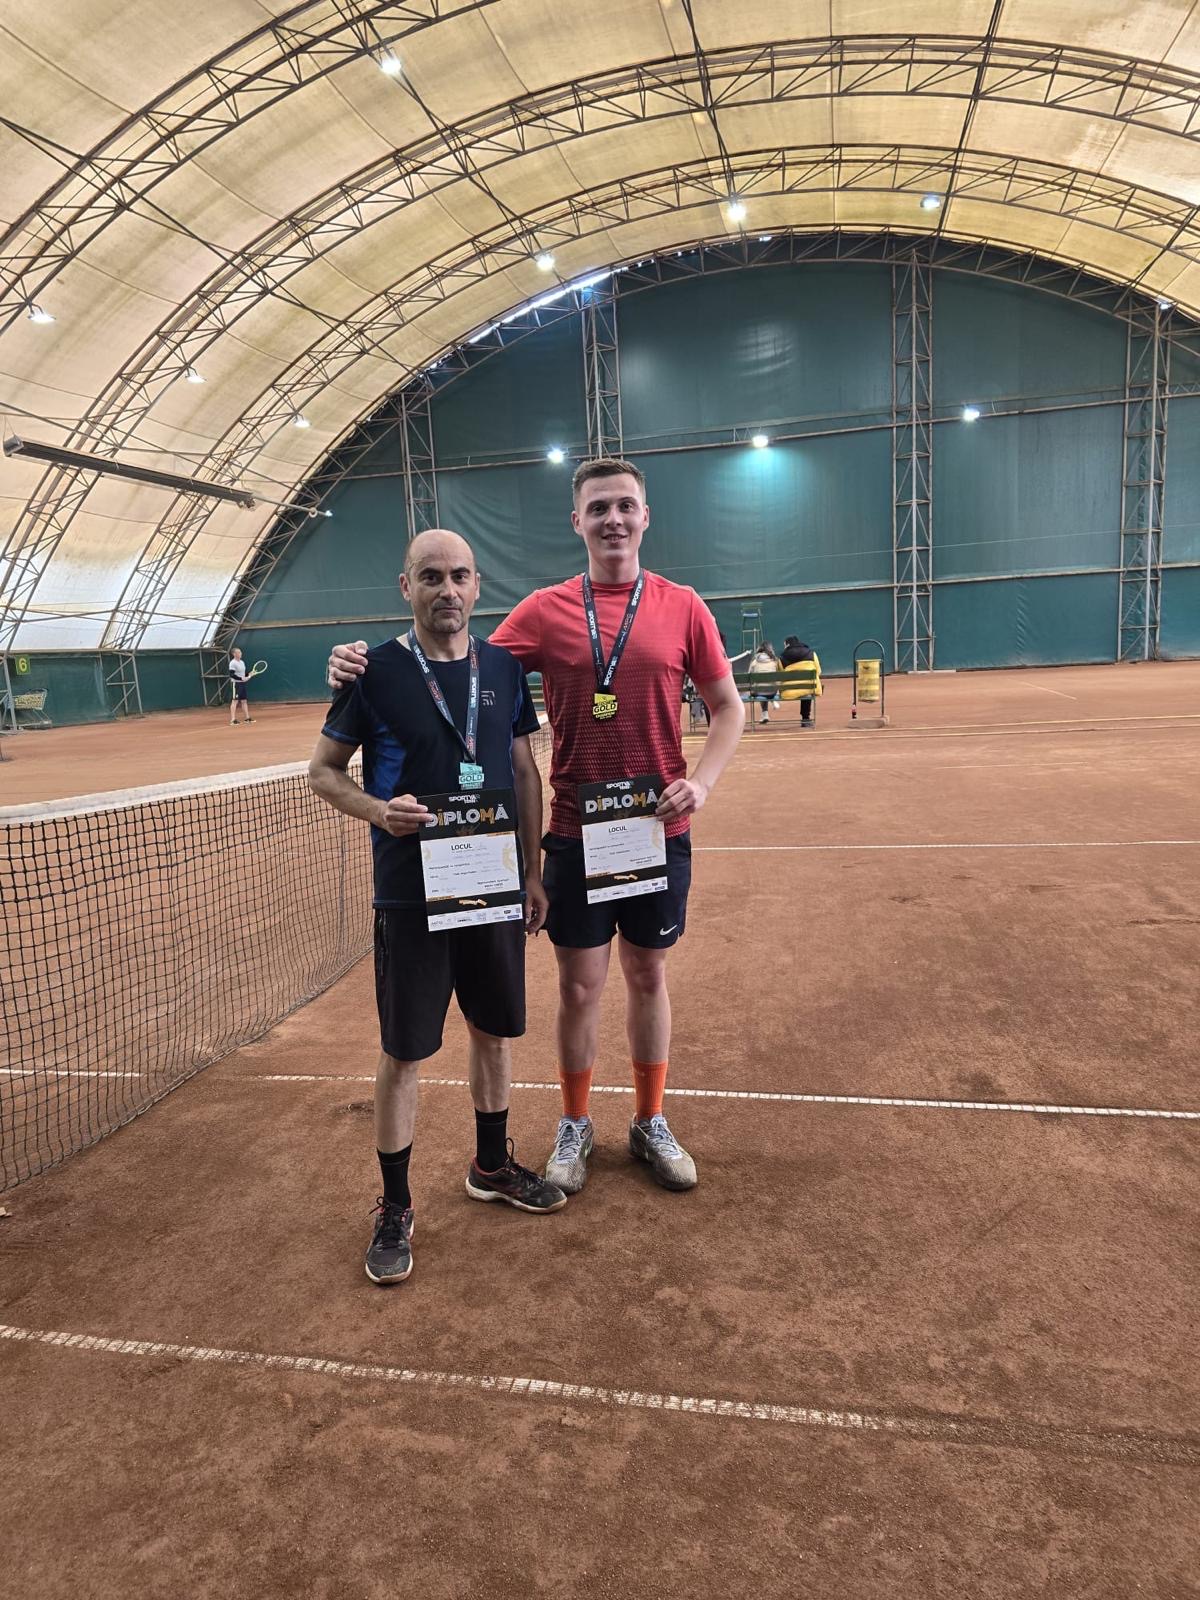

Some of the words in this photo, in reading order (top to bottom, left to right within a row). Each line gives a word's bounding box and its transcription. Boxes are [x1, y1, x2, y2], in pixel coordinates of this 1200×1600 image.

[19, 657, 28, 672] 6
[594, 703, 617, 713] GOLD
[459, 774, 483, 783] GOLD
[585, 788, 658, 814] DIPLOMĂ
[608, 825, 628, 833] LOCUL
[450, 843, 473, 851] LOCUL
